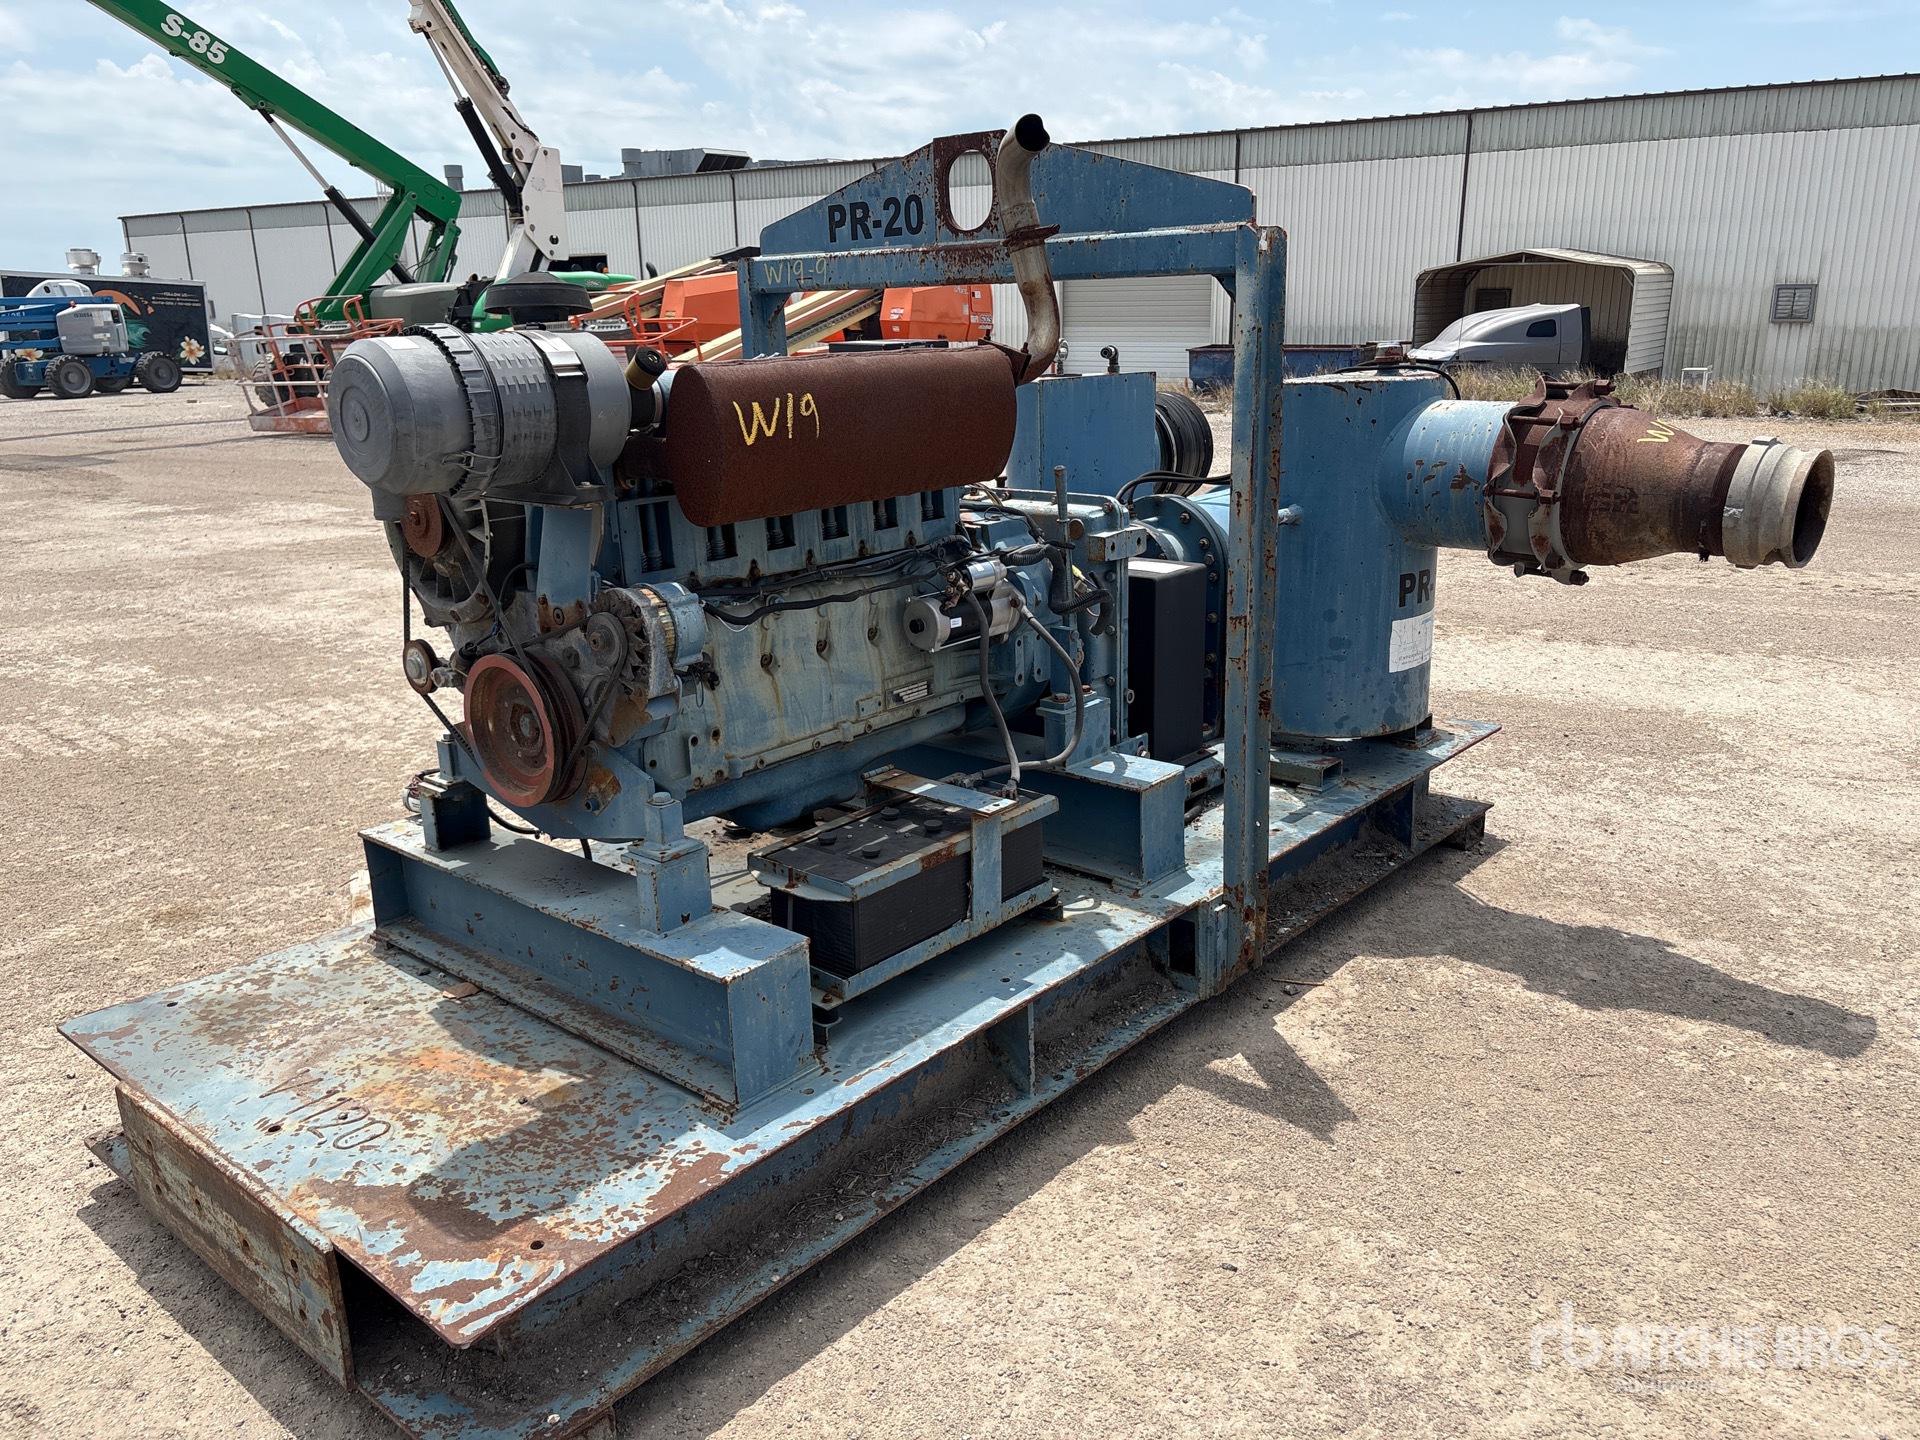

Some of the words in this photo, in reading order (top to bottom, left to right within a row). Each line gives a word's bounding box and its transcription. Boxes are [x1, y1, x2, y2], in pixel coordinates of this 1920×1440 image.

[160, 13, 229, 65] S-85
[827, 194, 924, 243] PR-20
[732, 392, 820, 446] W19
